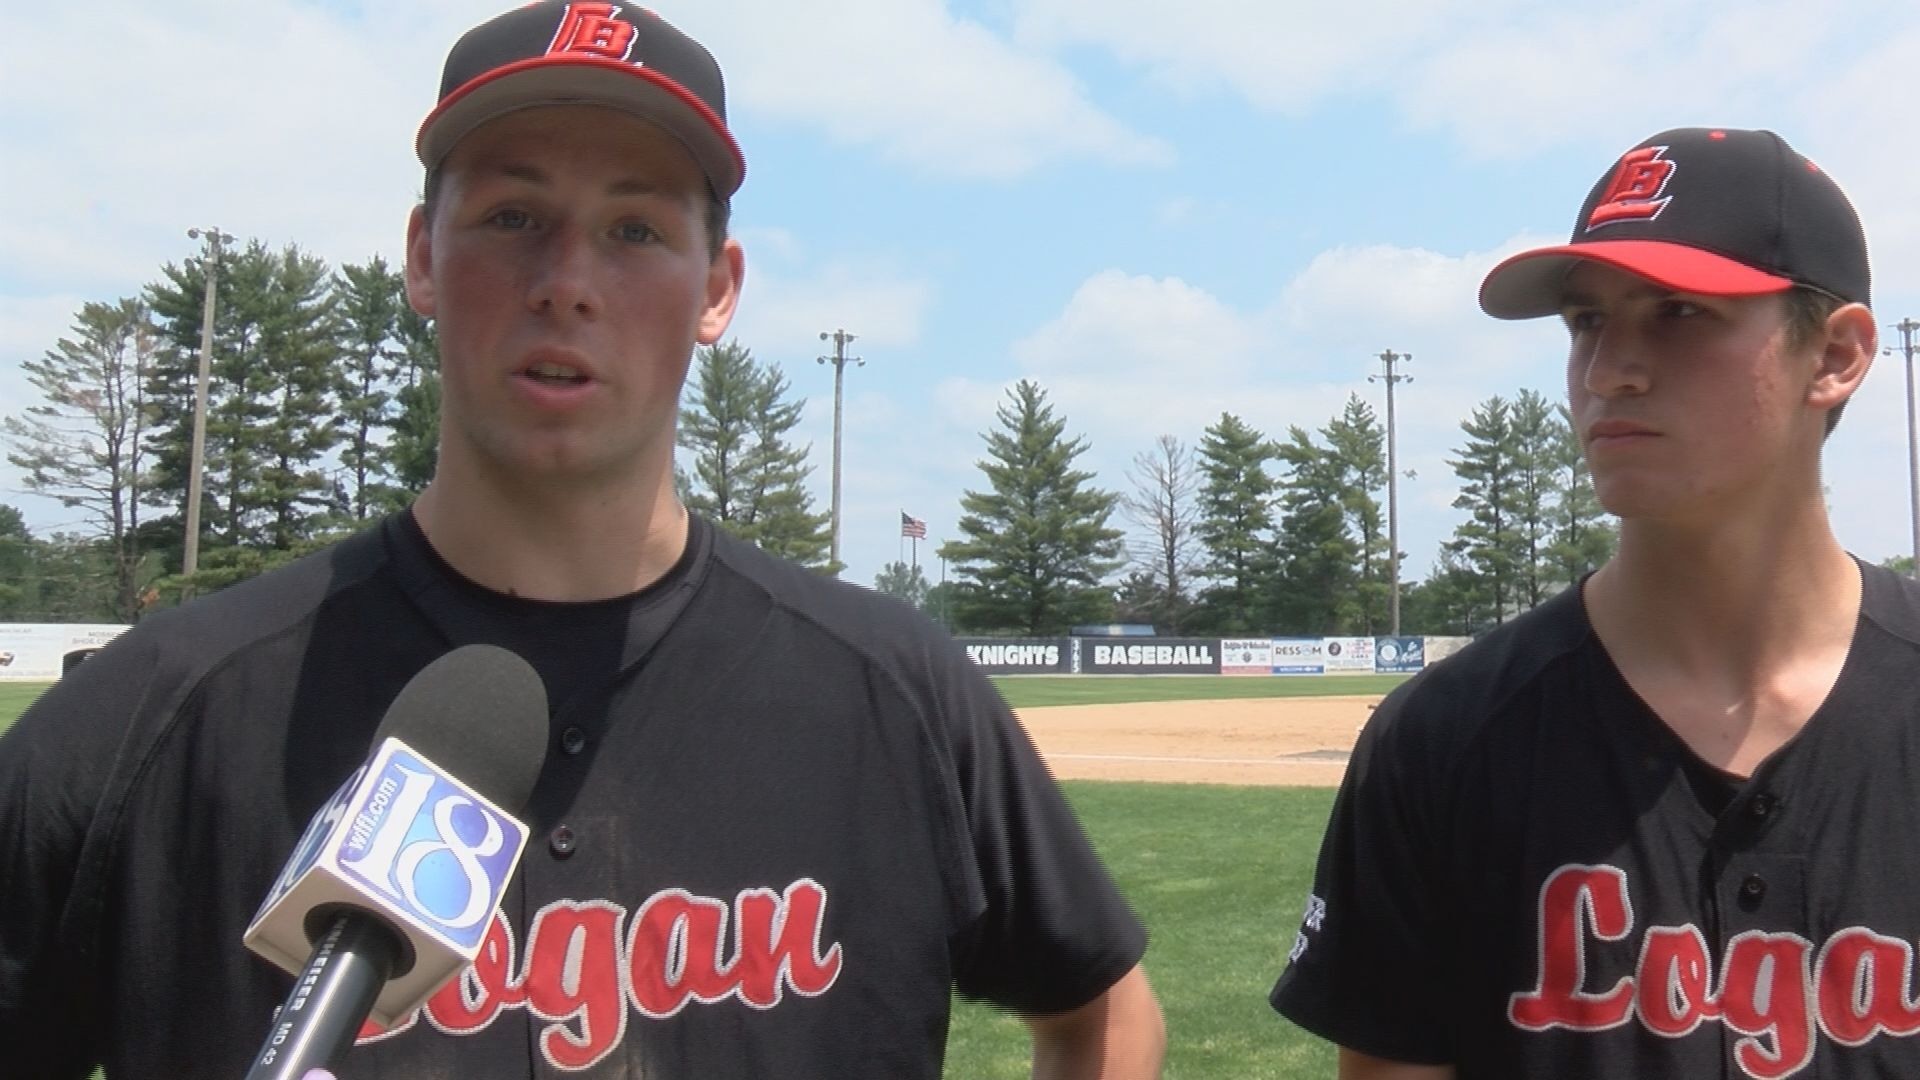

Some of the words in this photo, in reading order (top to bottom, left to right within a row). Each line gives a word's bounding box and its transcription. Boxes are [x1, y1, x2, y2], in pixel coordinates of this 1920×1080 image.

[966, 645, 1059, 665] KNIGHTS
[1094, 645, 1213, 665] BASEBALL
[338, 762, 504, 929] 18
[272, 878, 842, 1071] ogan
[1508, 864, 1920, 1080] Loga
